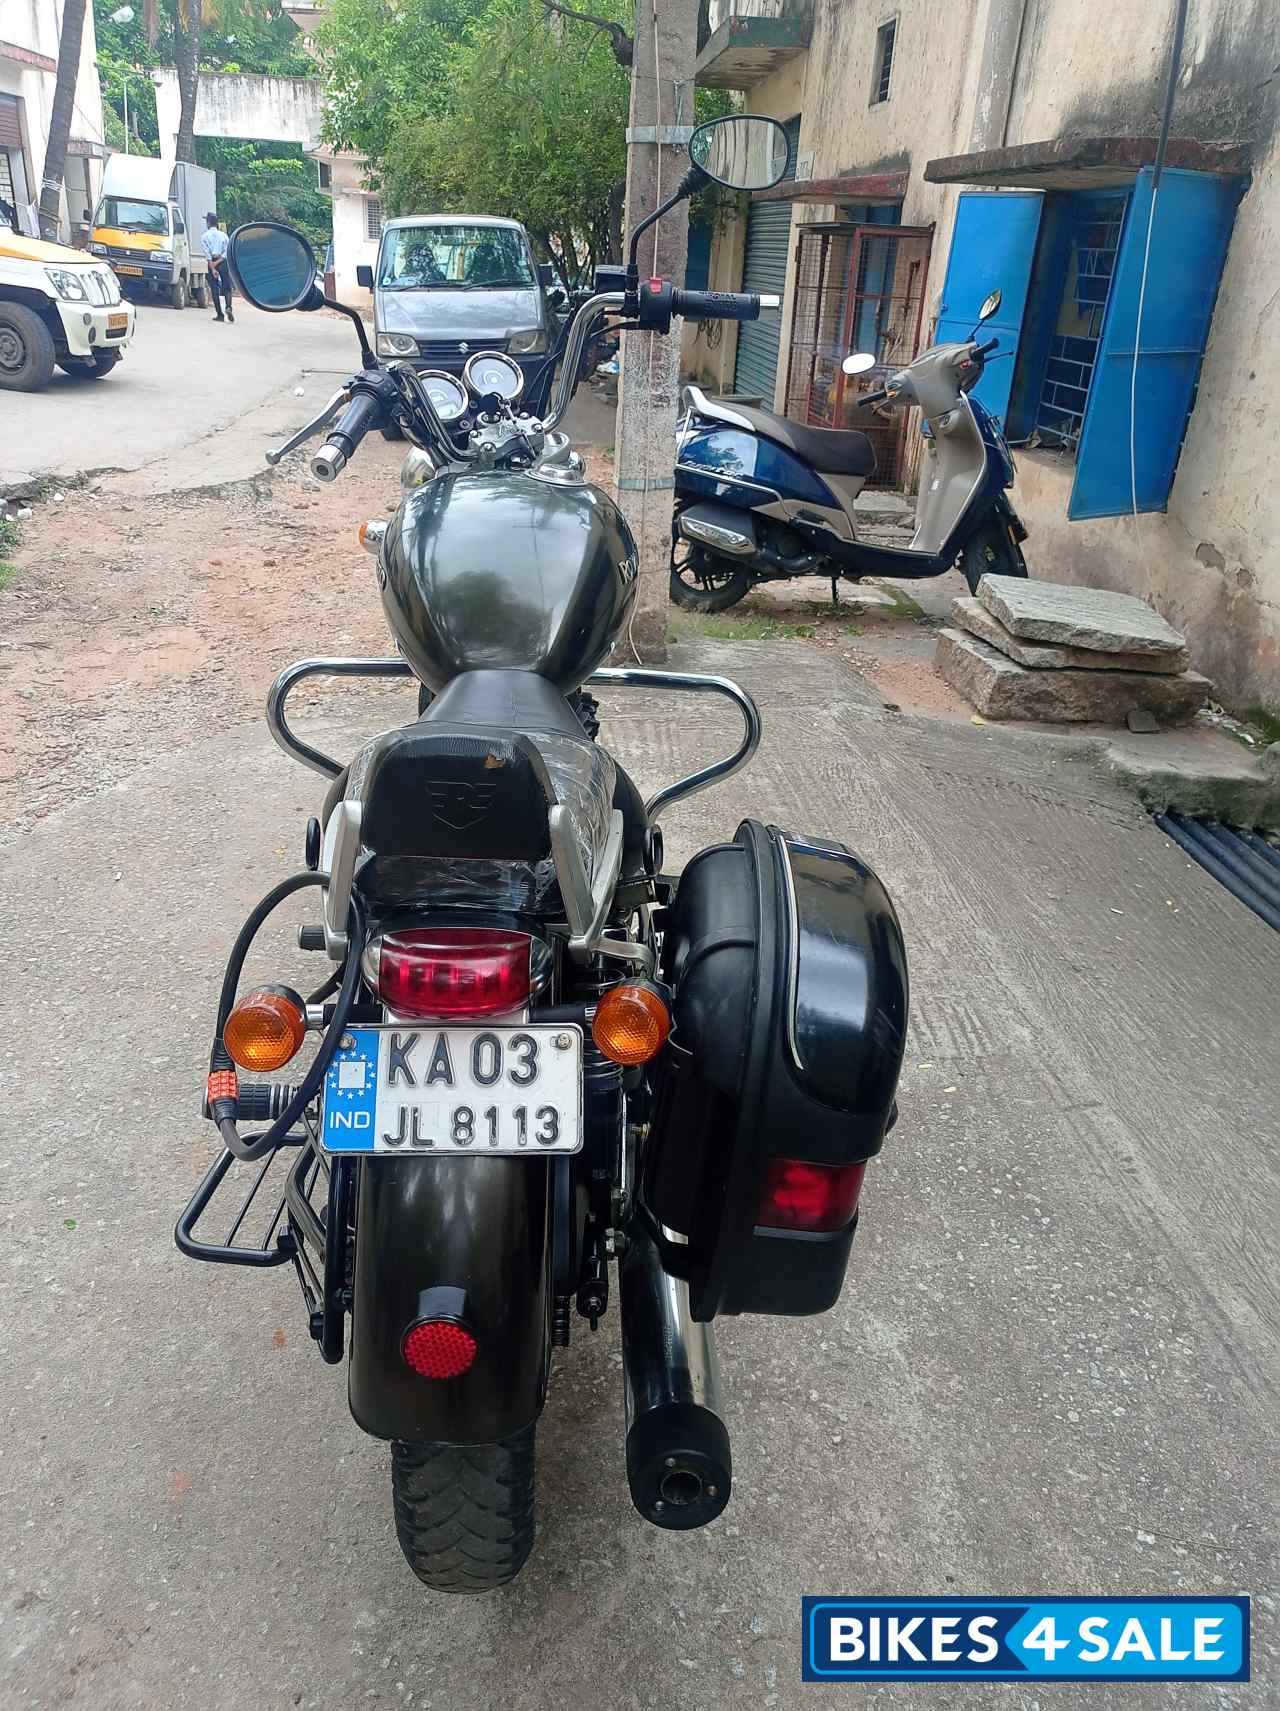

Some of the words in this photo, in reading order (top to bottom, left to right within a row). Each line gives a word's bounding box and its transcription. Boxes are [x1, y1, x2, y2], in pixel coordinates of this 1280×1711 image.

[387, 1031, 455, 1087] KA
[471, 1032, 540, 1087] 03
[329, 1111, 370, 1129] IND
[383, 1105, 435, 1147] JL
[450, 1104, 562, 1147] 8113
